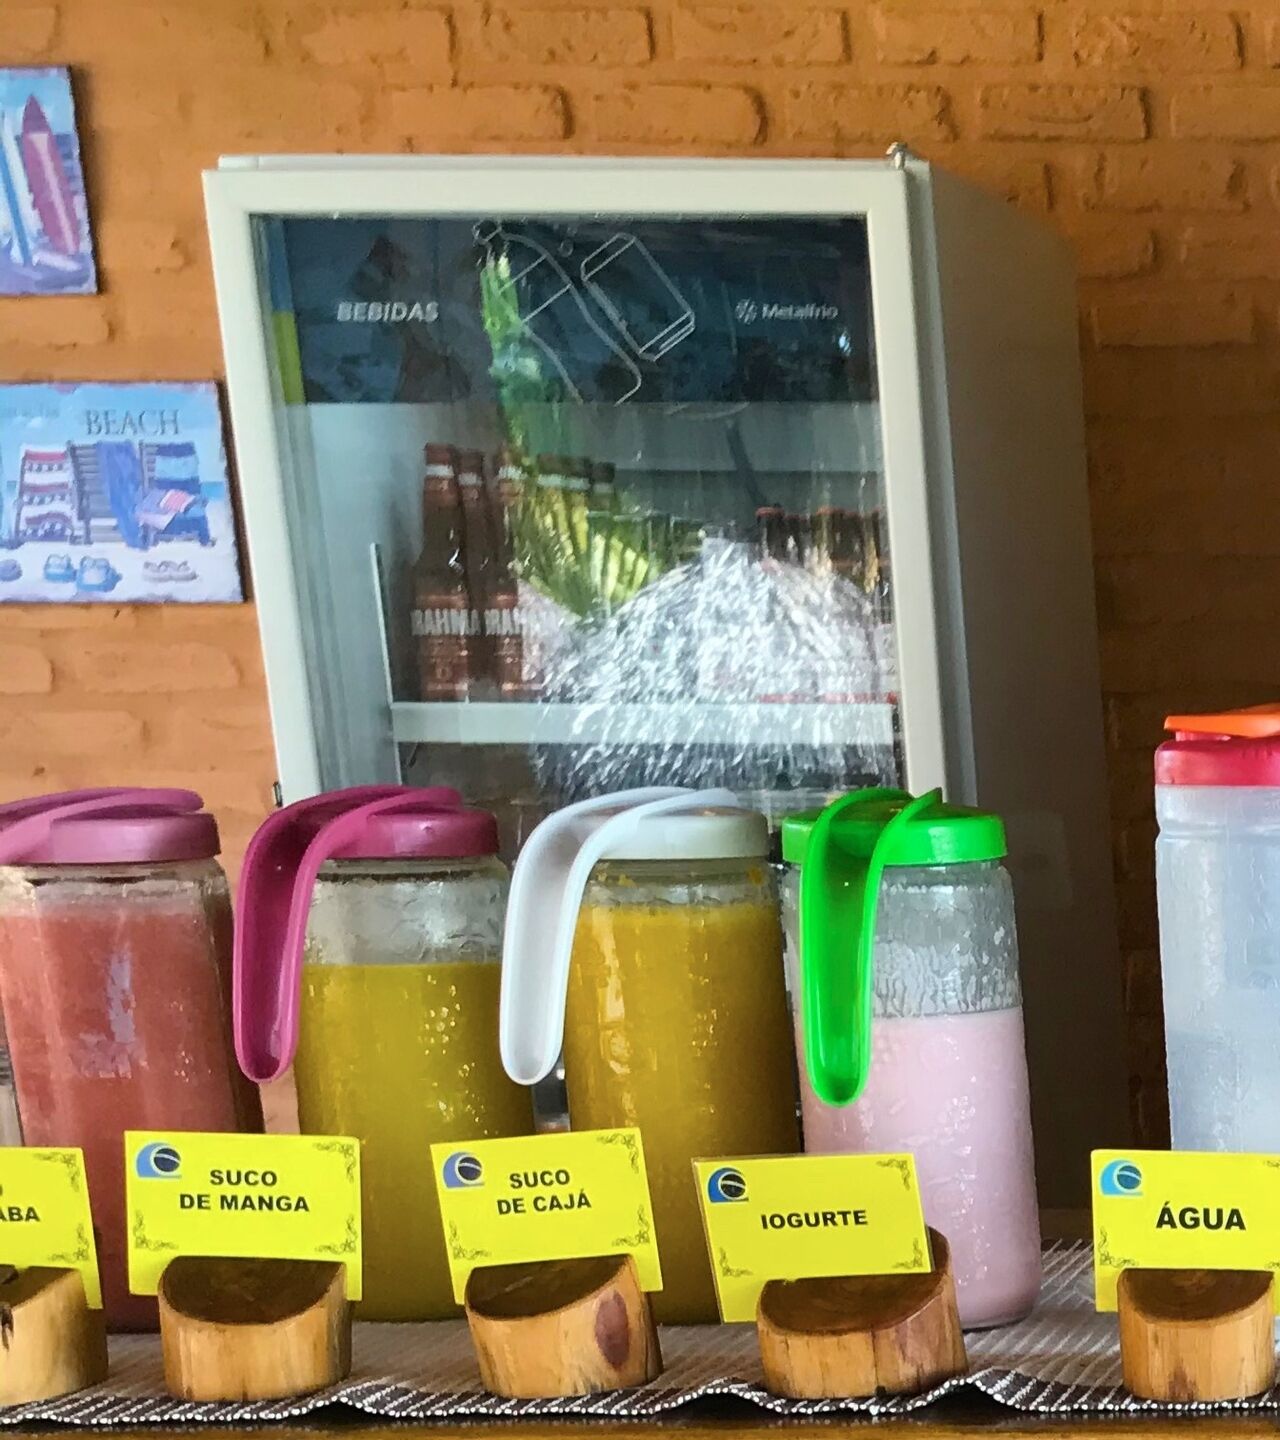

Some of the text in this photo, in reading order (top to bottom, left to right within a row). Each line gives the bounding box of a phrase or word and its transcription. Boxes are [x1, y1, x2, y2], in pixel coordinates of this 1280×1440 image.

[337, 301, 439, 322] BEBIDAS
[86, 408, 180, 436] BEACH
[209, 1169, 278, 1187] SUCO
[509, 1168, 570, 1189] SUCO
[179, 1193, 310, 1213] DE MANGA
[497, 1188, 592, 1217] DE CAJÁ
[761, 1209, 868, 1230] IOGURTE
[1156, 1201, 1247, 1231] ÁGUA
